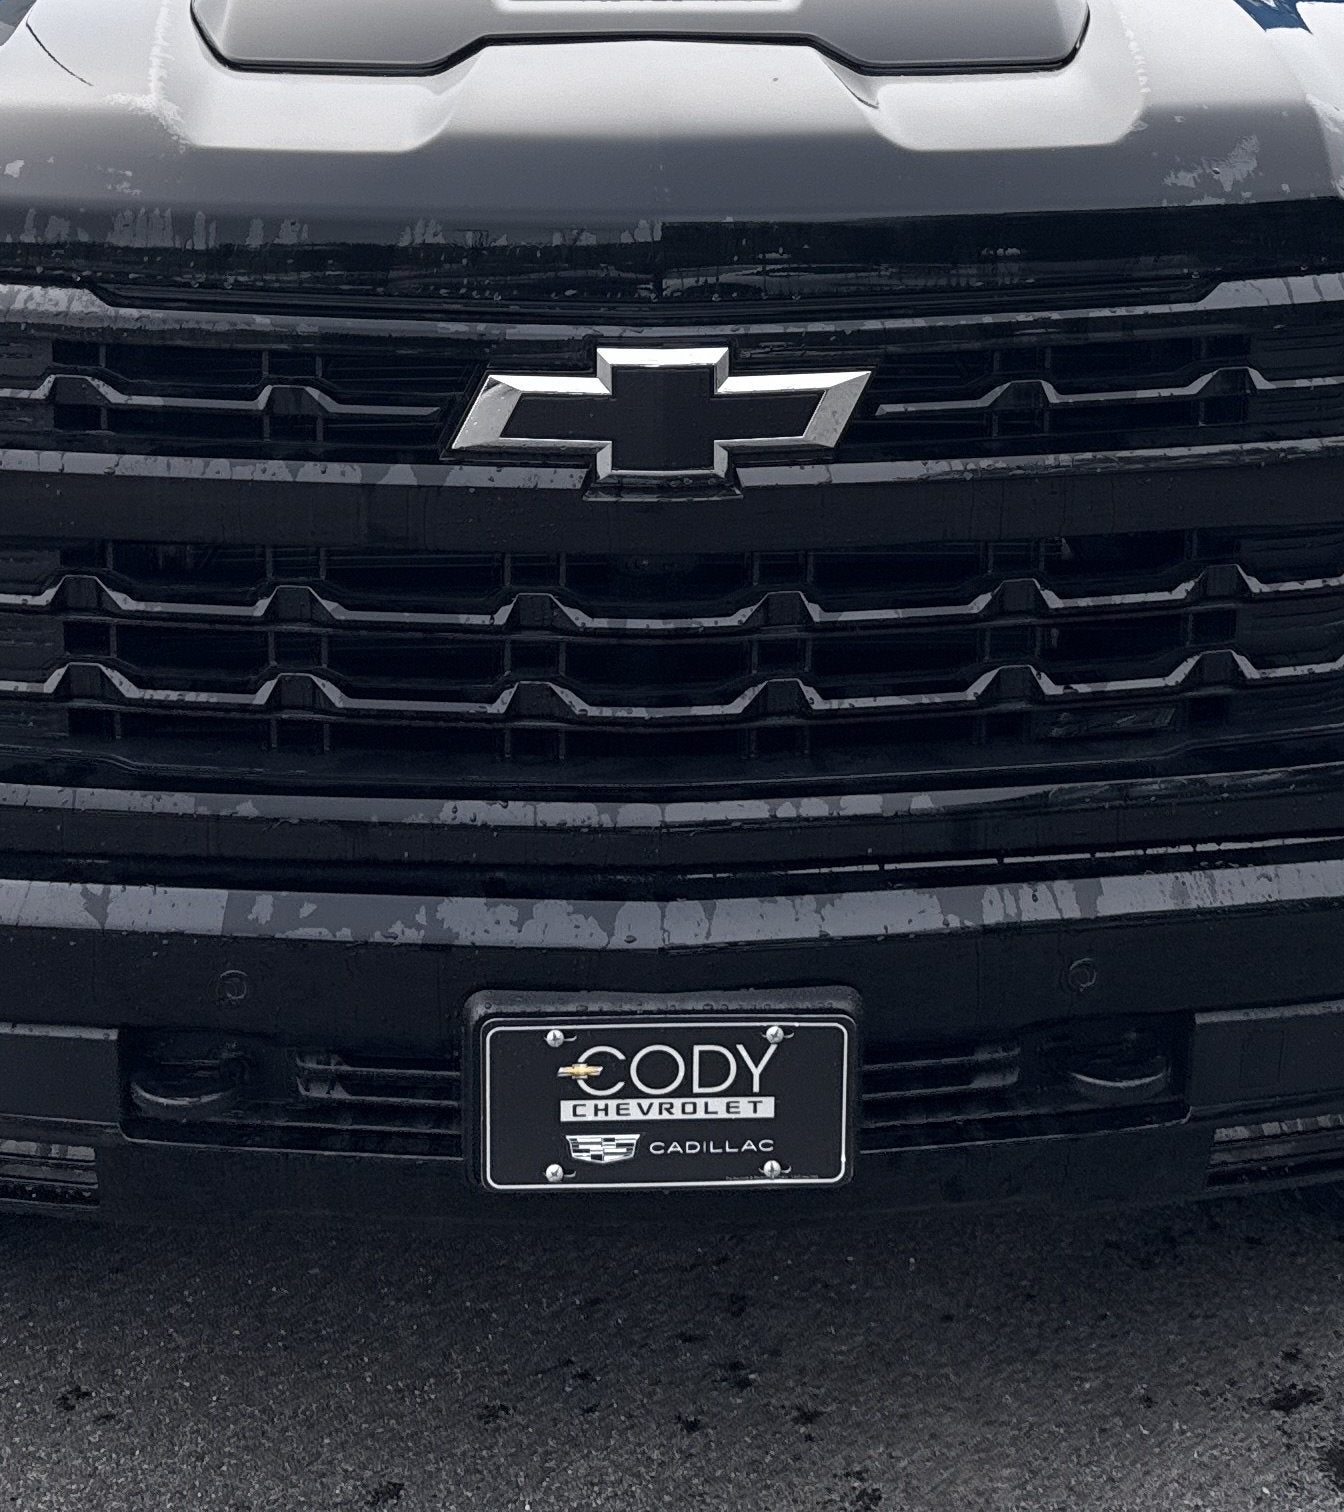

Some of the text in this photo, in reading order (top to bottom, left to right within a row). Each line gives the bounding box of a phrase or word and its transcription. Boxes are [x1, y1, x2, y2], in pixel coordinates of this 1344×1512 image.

[576, 1044, 778, 1096] CODY
[571, 1099, 764, 1118] CHEVROLET
[648, 1138, 774, 1156] CADILLAC
